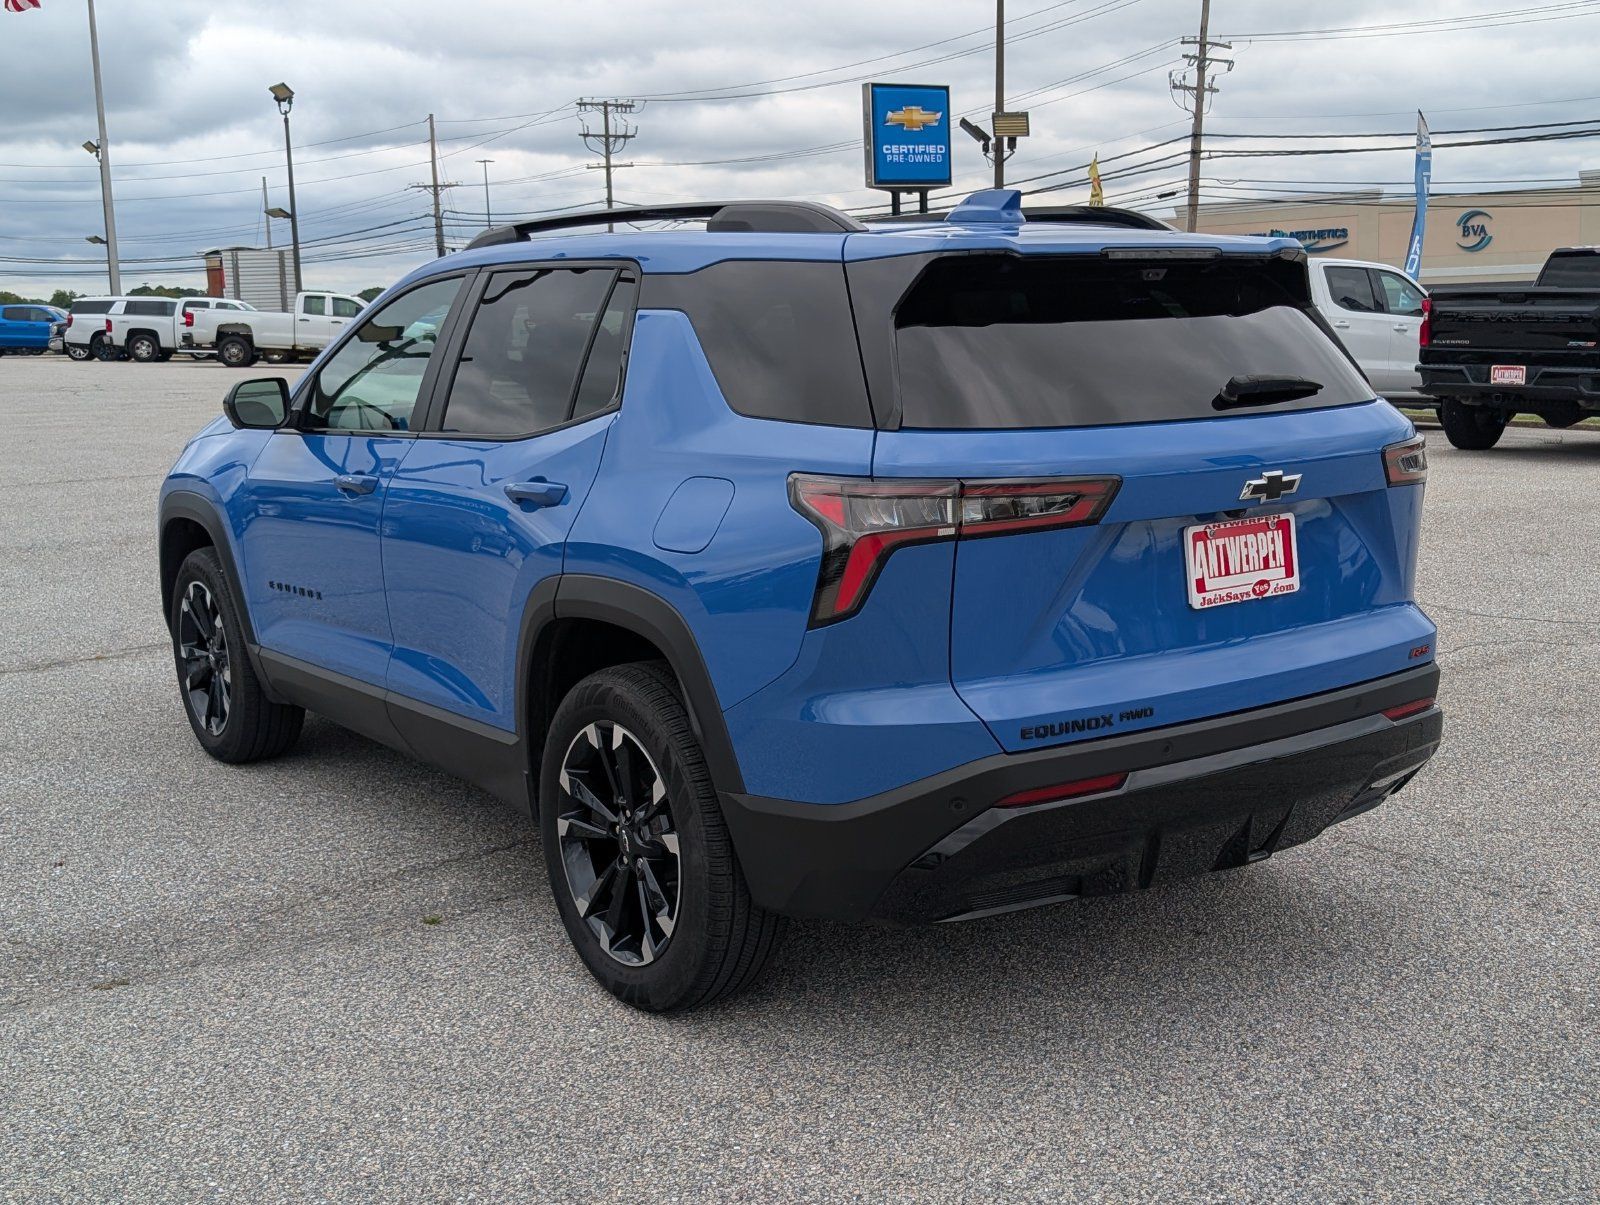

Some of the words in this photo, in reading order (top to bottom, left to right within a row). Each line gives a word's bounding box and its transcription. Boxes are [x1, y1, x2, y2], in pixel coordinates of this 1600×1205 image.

[882, 144, 946, 154] CERTIFIED
[886, 154, 943, 163] PRE-OWNED
[1288, 228, 1349, 241] AESTHETICS
[1461, 223, 1488, 238] BVA
[1203, 514, 1282, 531] ANTWERPEN
[1194, 529, 1285, 580] ANTWERPEN
[268, 580, 323, 600] EQUINOX
[1020, 713, 1114, 740] EQUINOX
[1119, 707, 1154, 722] AWD
